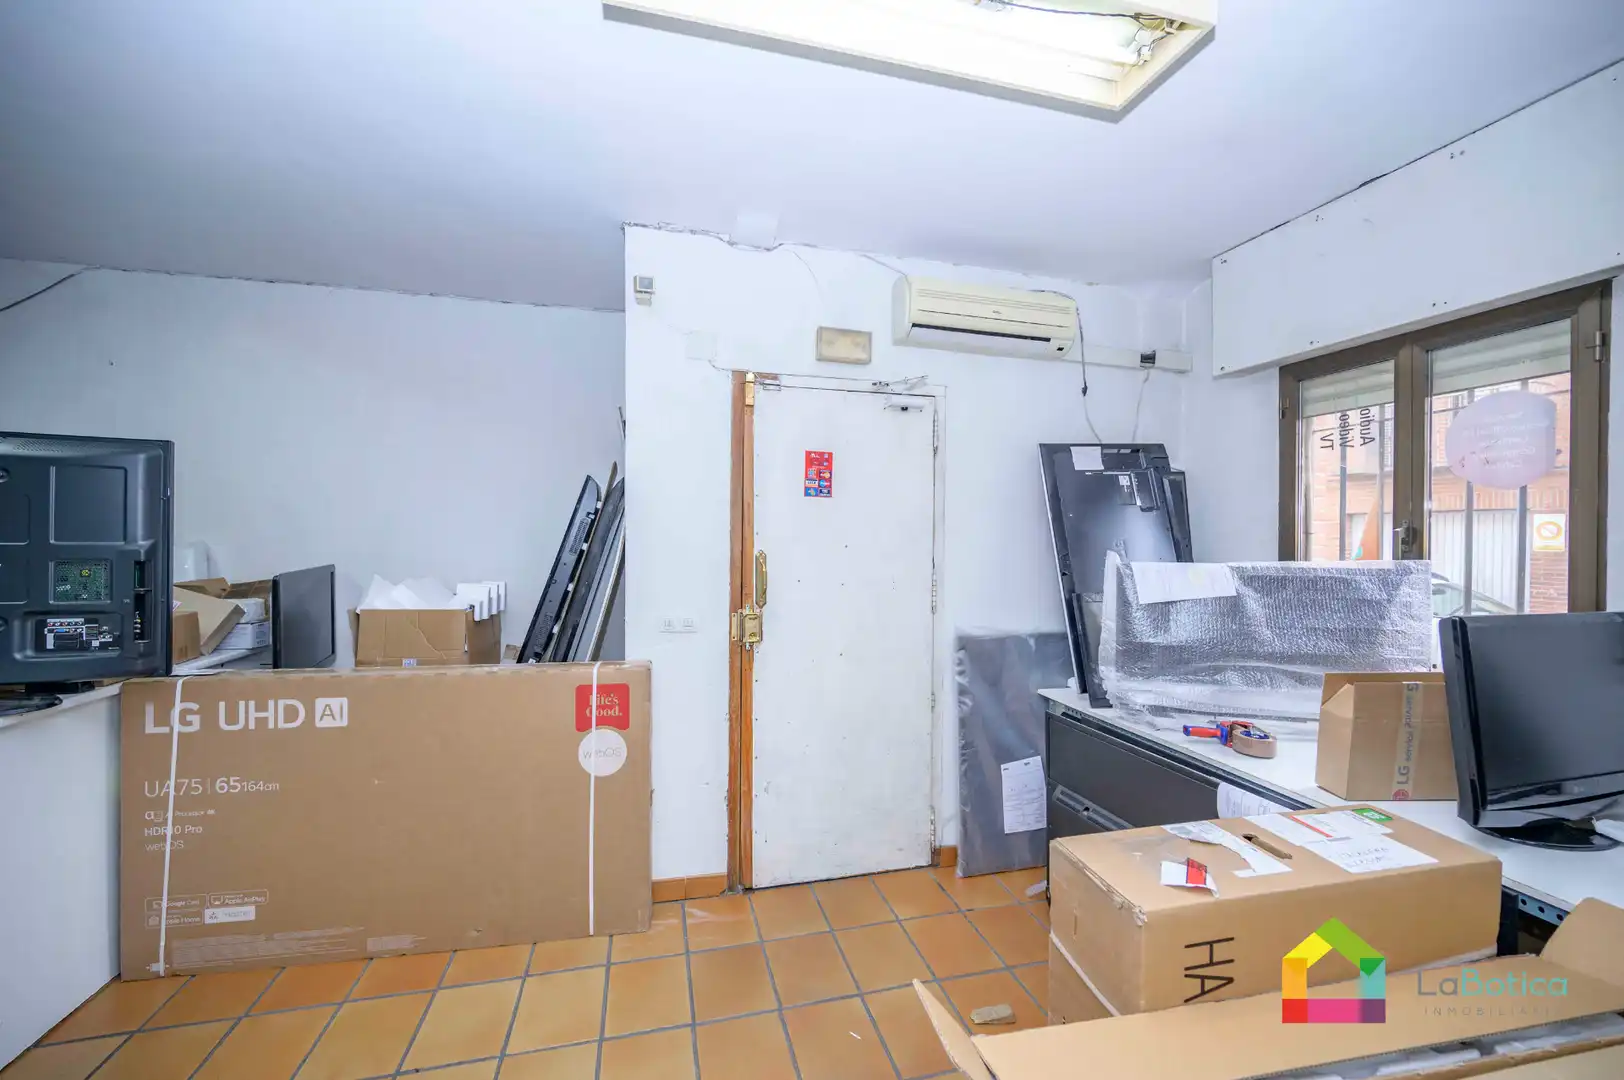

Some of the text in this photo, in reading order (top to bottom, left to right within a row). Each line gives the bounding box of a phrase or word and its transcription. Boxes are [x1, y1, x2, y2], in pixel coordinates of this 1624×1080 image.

[144, 698, 345, 734] LG UHD AI
[1396, 764, 1410, 786] LG
[144, 777, 203, 798] UA75
[144, 823, 203, 837] HDR0 Pro
[1183, 935, 1236, 1004] HA
